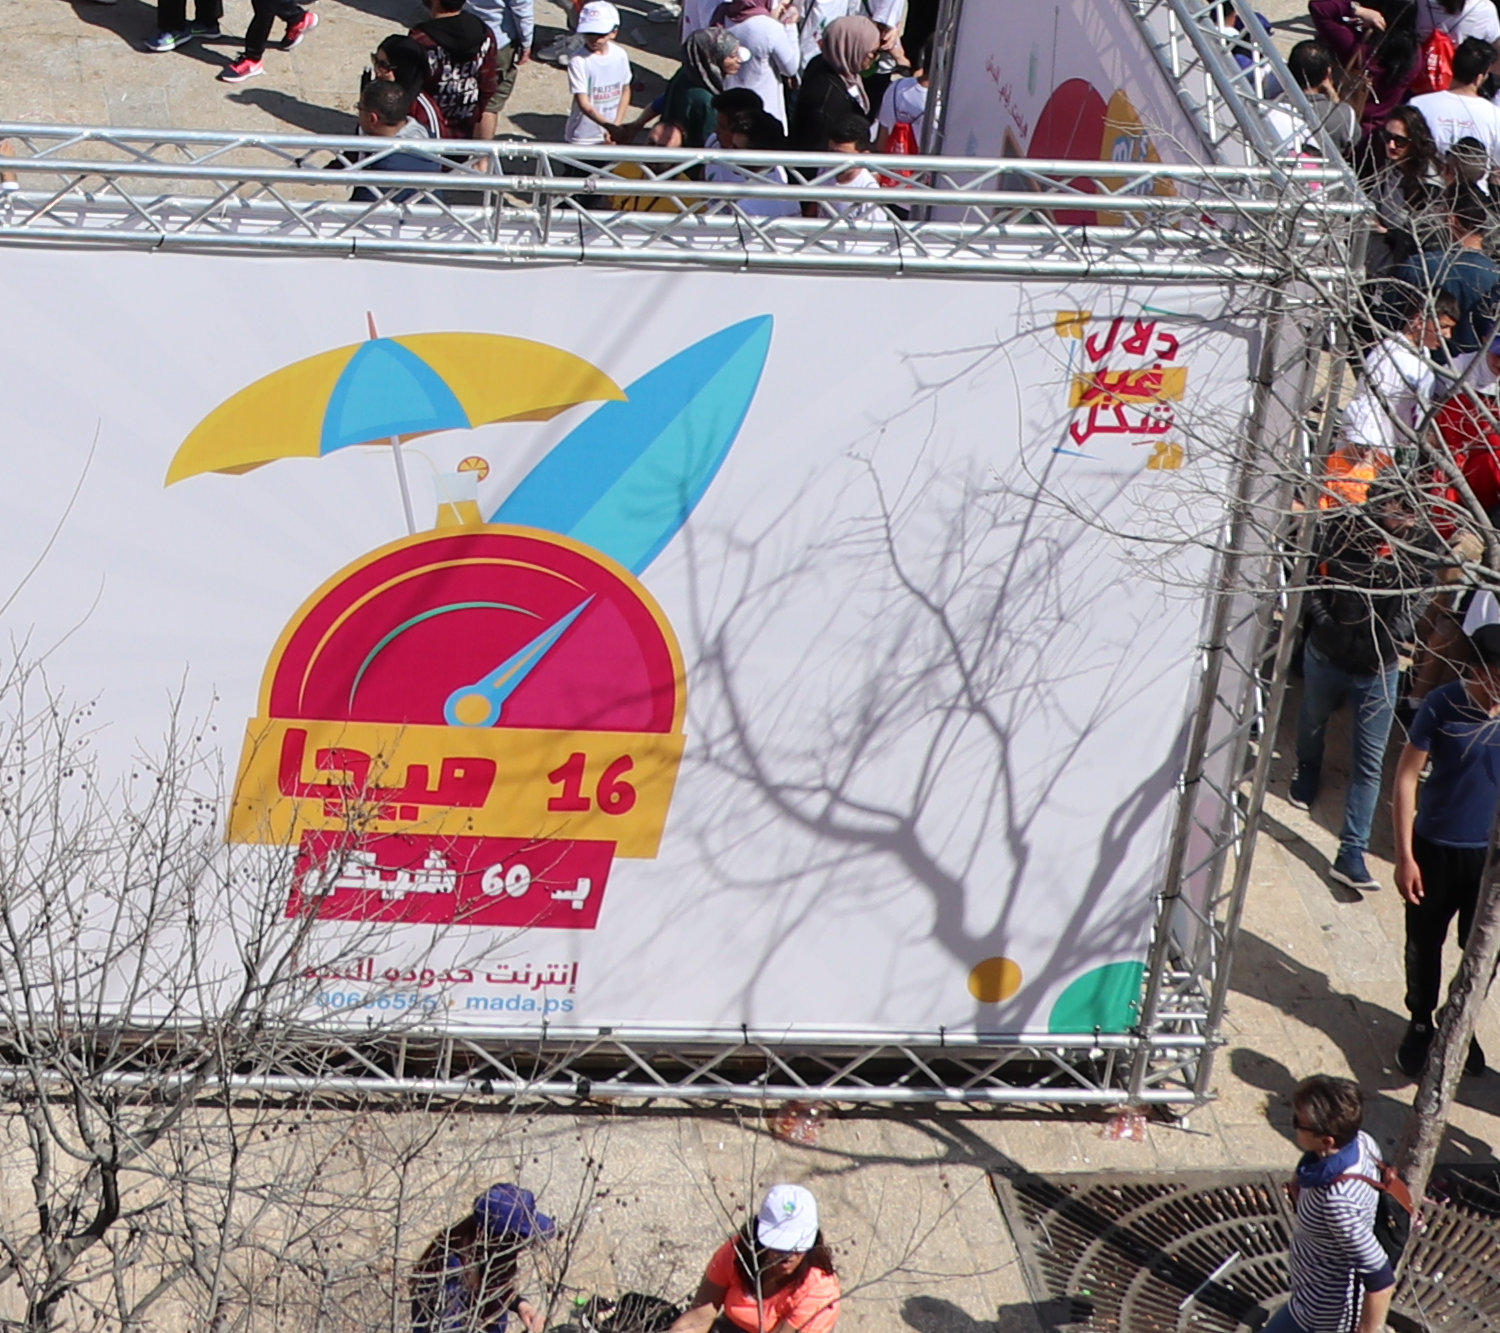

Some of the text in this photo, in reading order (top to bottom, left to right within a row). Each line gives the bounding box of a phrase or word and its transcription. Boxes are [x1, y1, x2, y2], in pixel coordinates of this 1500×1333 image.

[546, 751, 638, 816] 16
[480, 862, 532, 898] 60
[465, 993, 576, 1015] mada.ps
